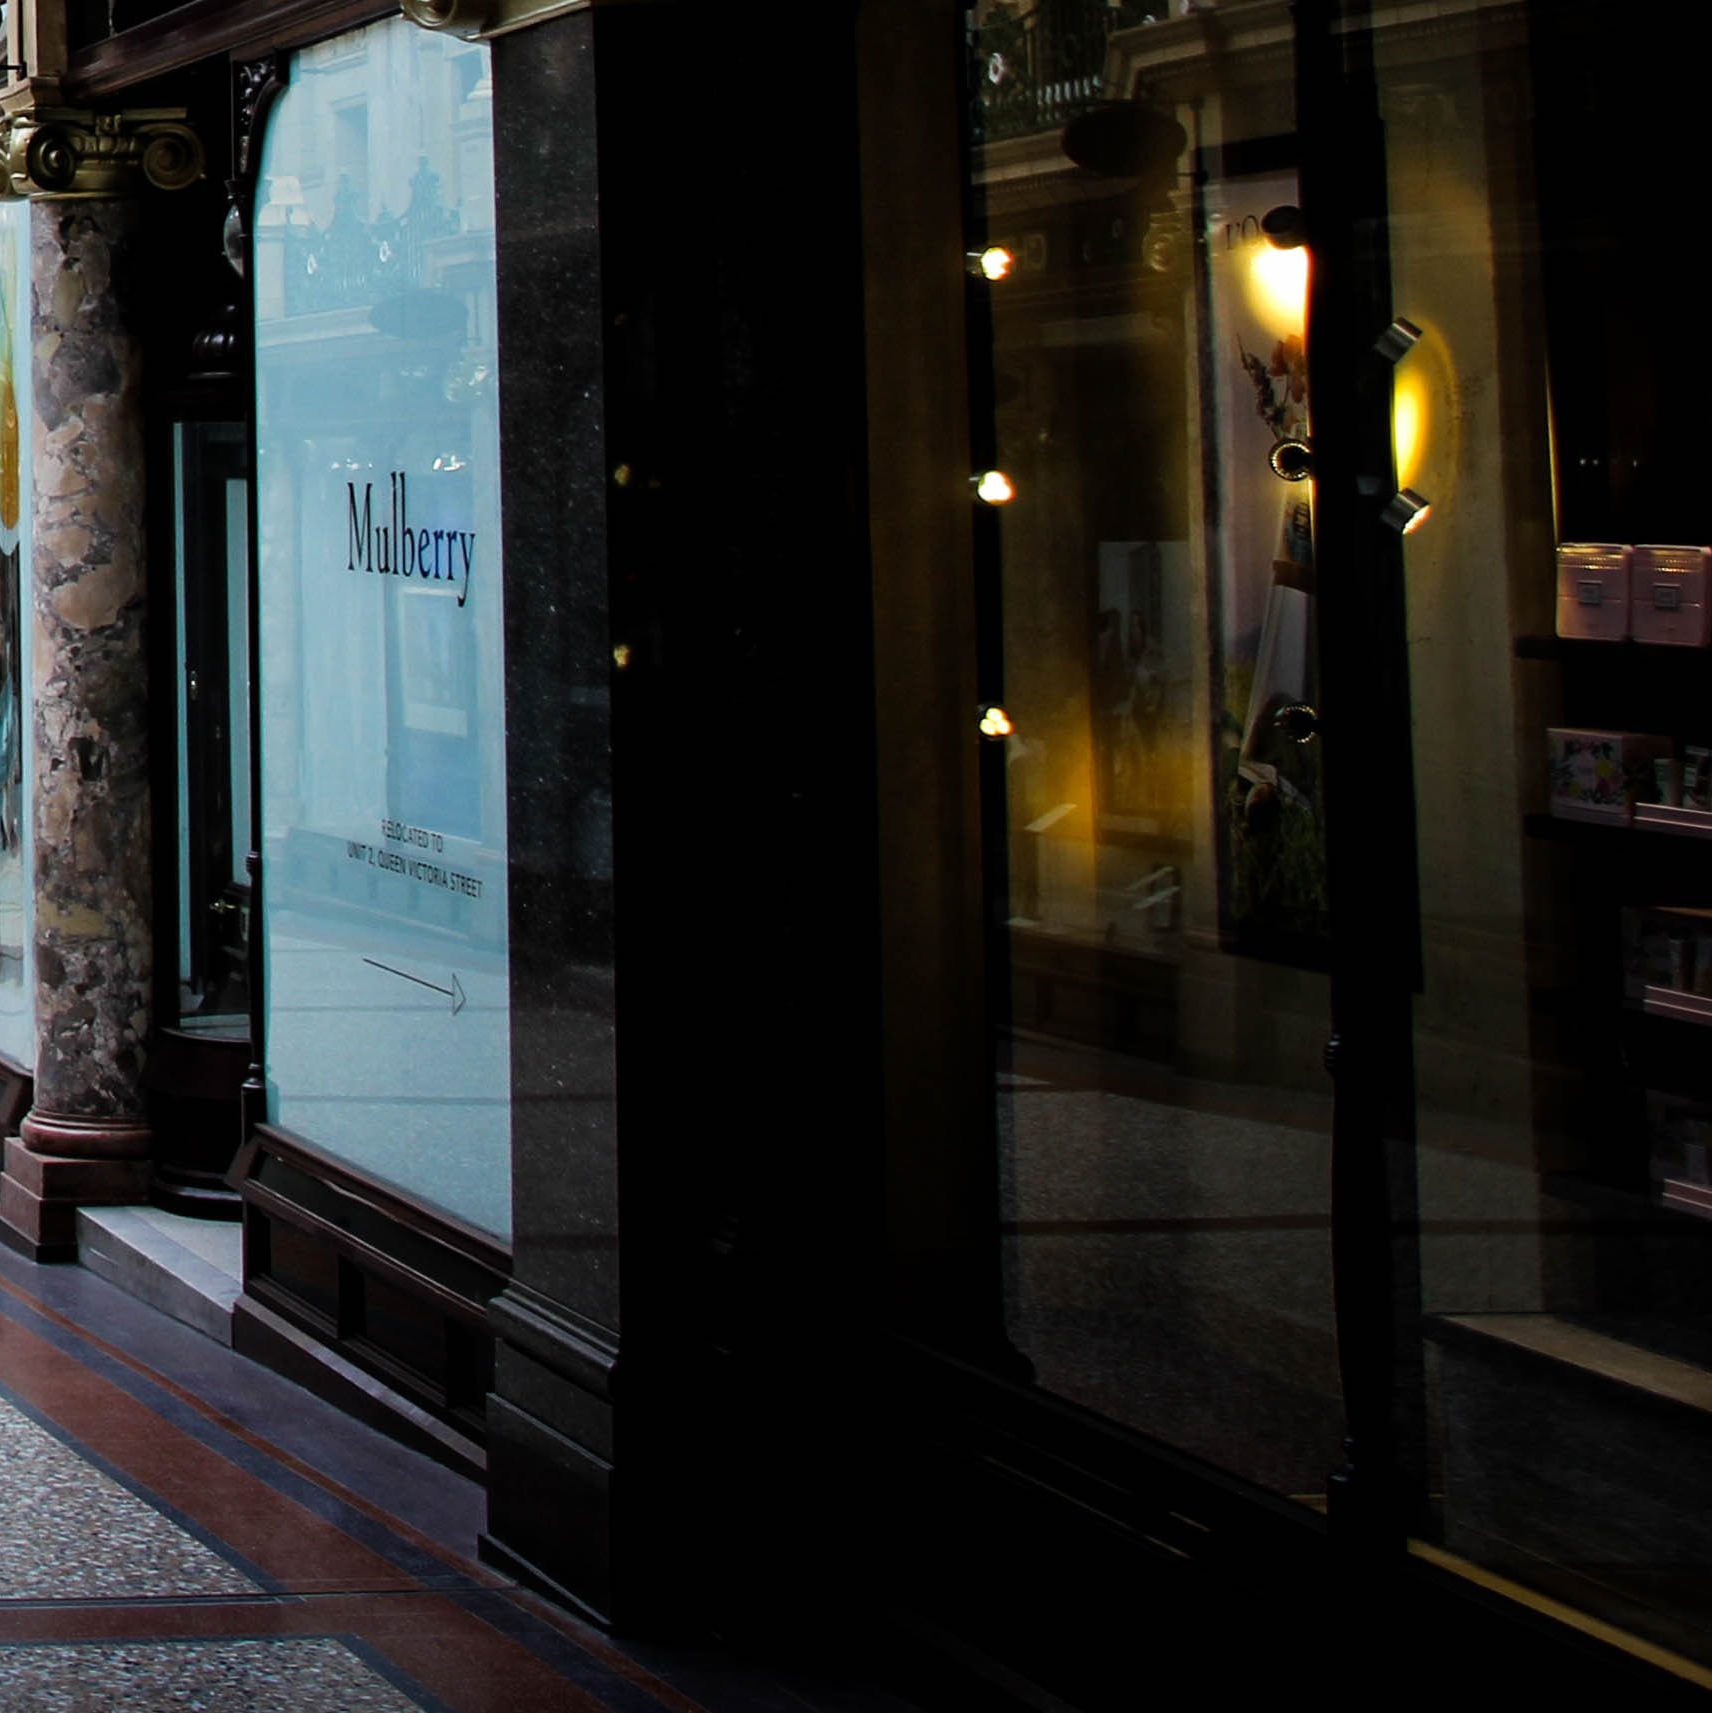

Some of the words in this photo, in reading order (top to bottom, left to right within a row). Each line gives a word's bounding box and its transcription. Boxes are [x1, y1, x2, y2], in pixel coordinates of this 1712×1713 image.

[347, 471, 476, 608] Mulberry
[431, 834, 444, 853] TO
[378, 850, 406, 875] QUEEN
[408, 859, 449, 889] VICTORIA
[450, 872, 483, 899] STREET
